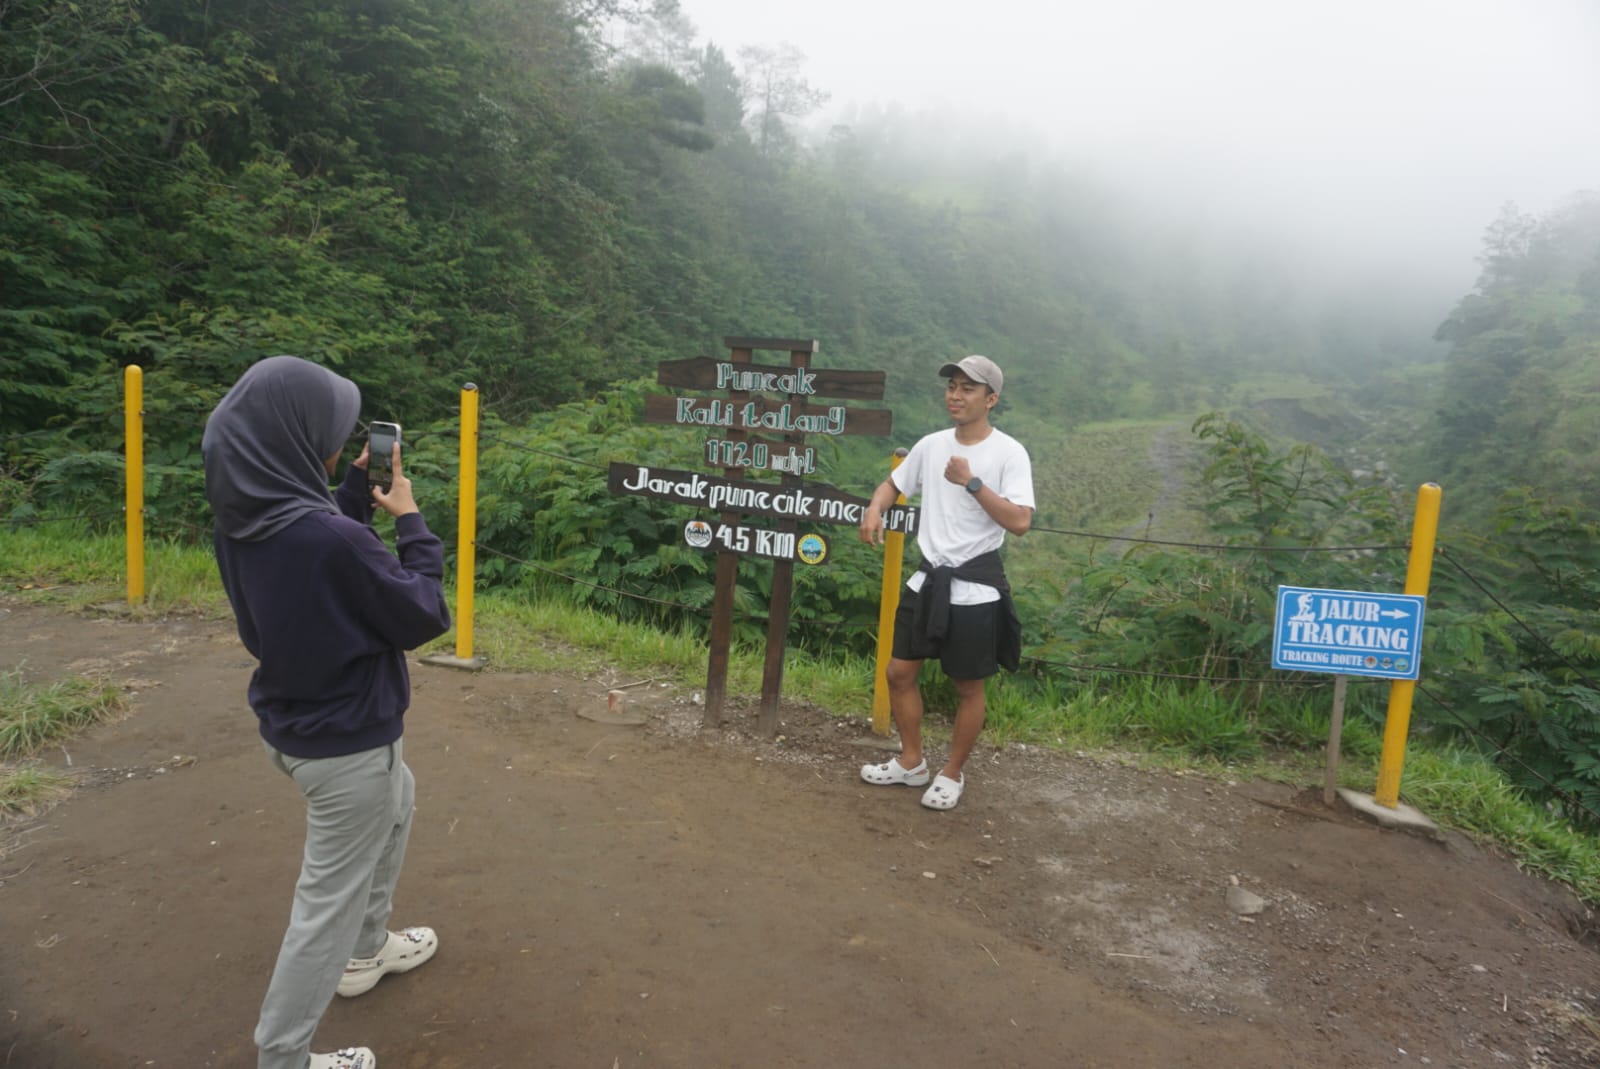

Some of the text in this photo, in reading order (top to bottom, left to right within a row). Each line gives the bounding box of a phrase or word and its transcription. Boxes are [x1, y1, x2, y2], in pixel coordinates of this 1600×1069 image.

[716, 363, 817, 395] Puncak
[676, 398, 846, 435] Kali talang
[707, 439, 768, 469] 1120
[623, 467, 709, 499] Jarak
[819, 499, 915, 534] mepi
[715, 524, 750, 552] 4.5
[1318, 598, 1380, 622] JALUR
[1288, 621, 1409, 651] TRACKING
[1282, 649, 1363, 667] TRACKING ROUTE
